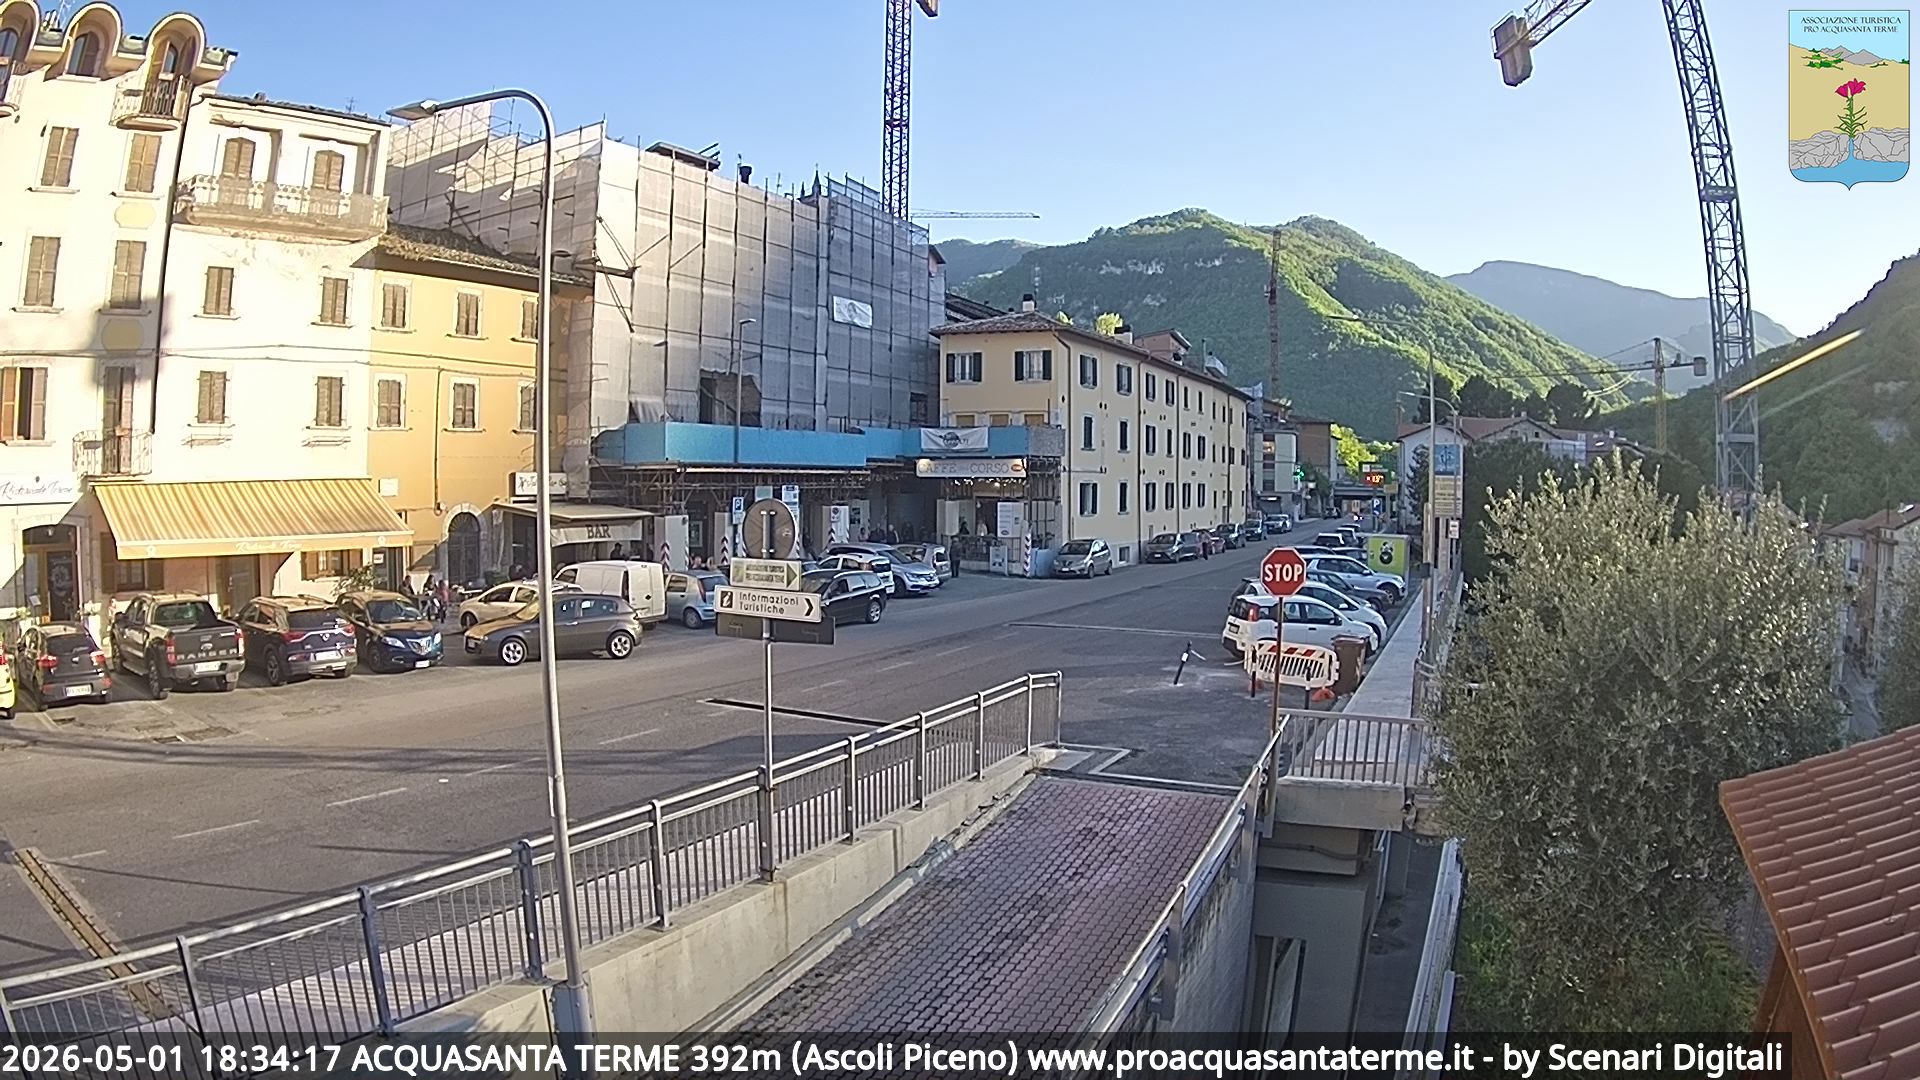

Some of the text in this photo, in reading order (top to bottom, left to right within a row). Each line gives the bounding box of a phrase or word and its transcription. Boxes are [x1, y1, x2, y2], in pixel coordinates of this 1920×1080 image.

[969, 463, 1010, 474] CORSO
[585, 524, 611, 539] BAR
[1264, 564, 1303, 582] STOP
[739, 591, 799, 606] Informazioni
[740, 602, 785, 615] Turistiche
